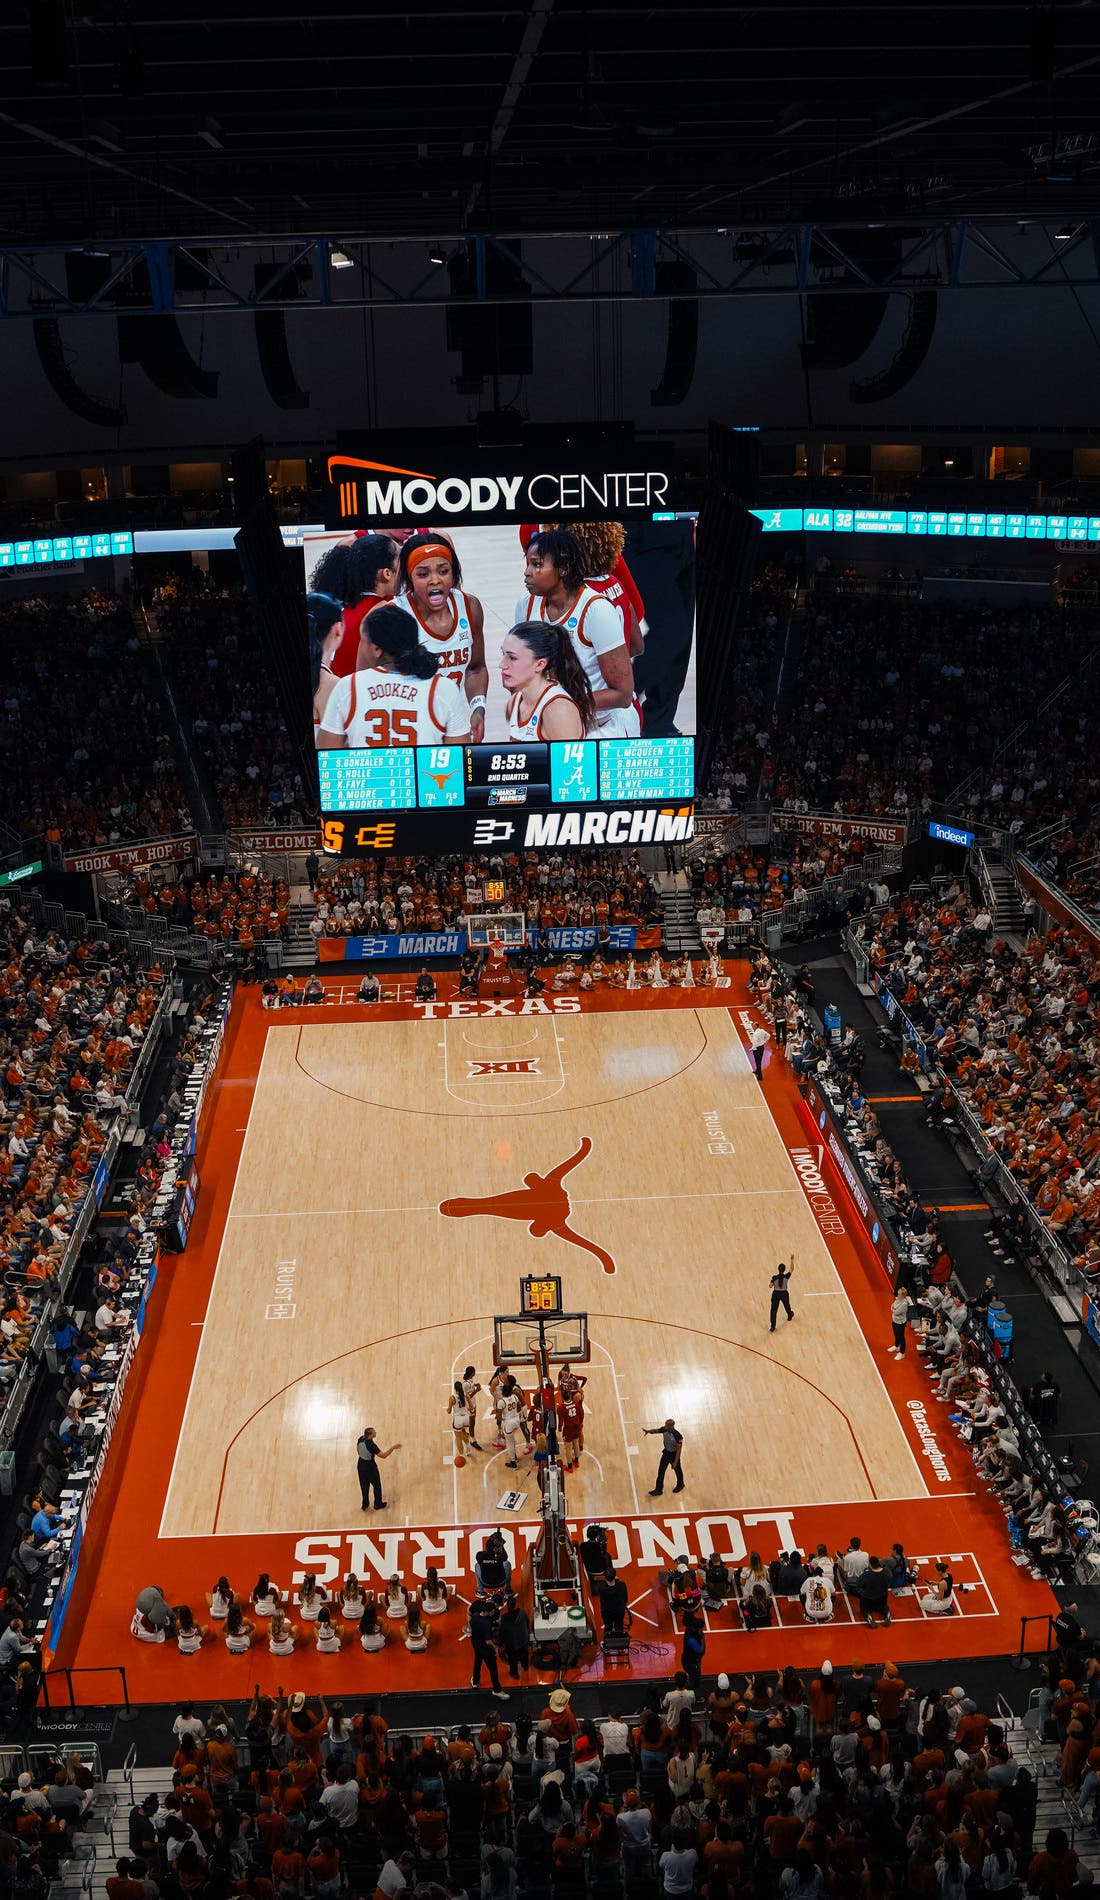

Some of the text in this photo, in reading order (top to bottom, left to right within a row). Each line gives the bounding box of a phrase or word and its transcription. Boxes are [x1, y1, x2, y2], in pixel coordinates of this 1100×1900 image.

[367, 472, 668, 515] MOODY CENTER
[806, 513, 830, 526] ALA
[836, 514, 852, 527] 32
[1073, 519, 1082, 527] FT
[437, 647, 468, 668] EXAS
[367, 683, 418, 703] BOOKER
[364, 709, 417, 747] 35
[430, 749, 450, 769] 19
[563, 744, 584, 764] 14
[616, 747, 664, 758] L.MCQUEEN
[684, 747, 690, 755] 0
[336, 757, 384, 768] S.GONZALES
[491, 754, 526, 770] 8:53
[617, 758, 659, 768] S.BARKER
[337, 768, 372, 778] S.HOLLE
[390, 769, 394, 777] 1
[488, 773, 529, 782] 2ND QUARTER
[617, 768, 664, 778] K.WEATHERS
[337, 780, 366, 790] K.FAYE
[617, 780, 642, 789] A.NYE
[338, 789, 377, 800] A.MOORE
[617, 788, 665, 799] M.NEWMAN
[339, 799, 384, 809] M.BOOKER
[851, 825, 896, 841] HORNS
[935, 825, 967, 845] indeed
[242, 835, 317, 850] WELCOME
[75, 856, 112, 872] HOOK
[488, 889, 503, 900] 30
[398, 935, 459, 955] MARCH
[413, 996, 581, 1019] TEXAS
[702, 1110, 727, 1142] TRUIST
[792, 1153, 846, 1235] MOODY CENTER
[274, 1258, 297, 1301] TRUIST
[531, 1281, 555, 1292] 8:53
[906, 1400, 952, 1482] @TexasLonghorns
[41, 1723, 78, 1731] MOODY
